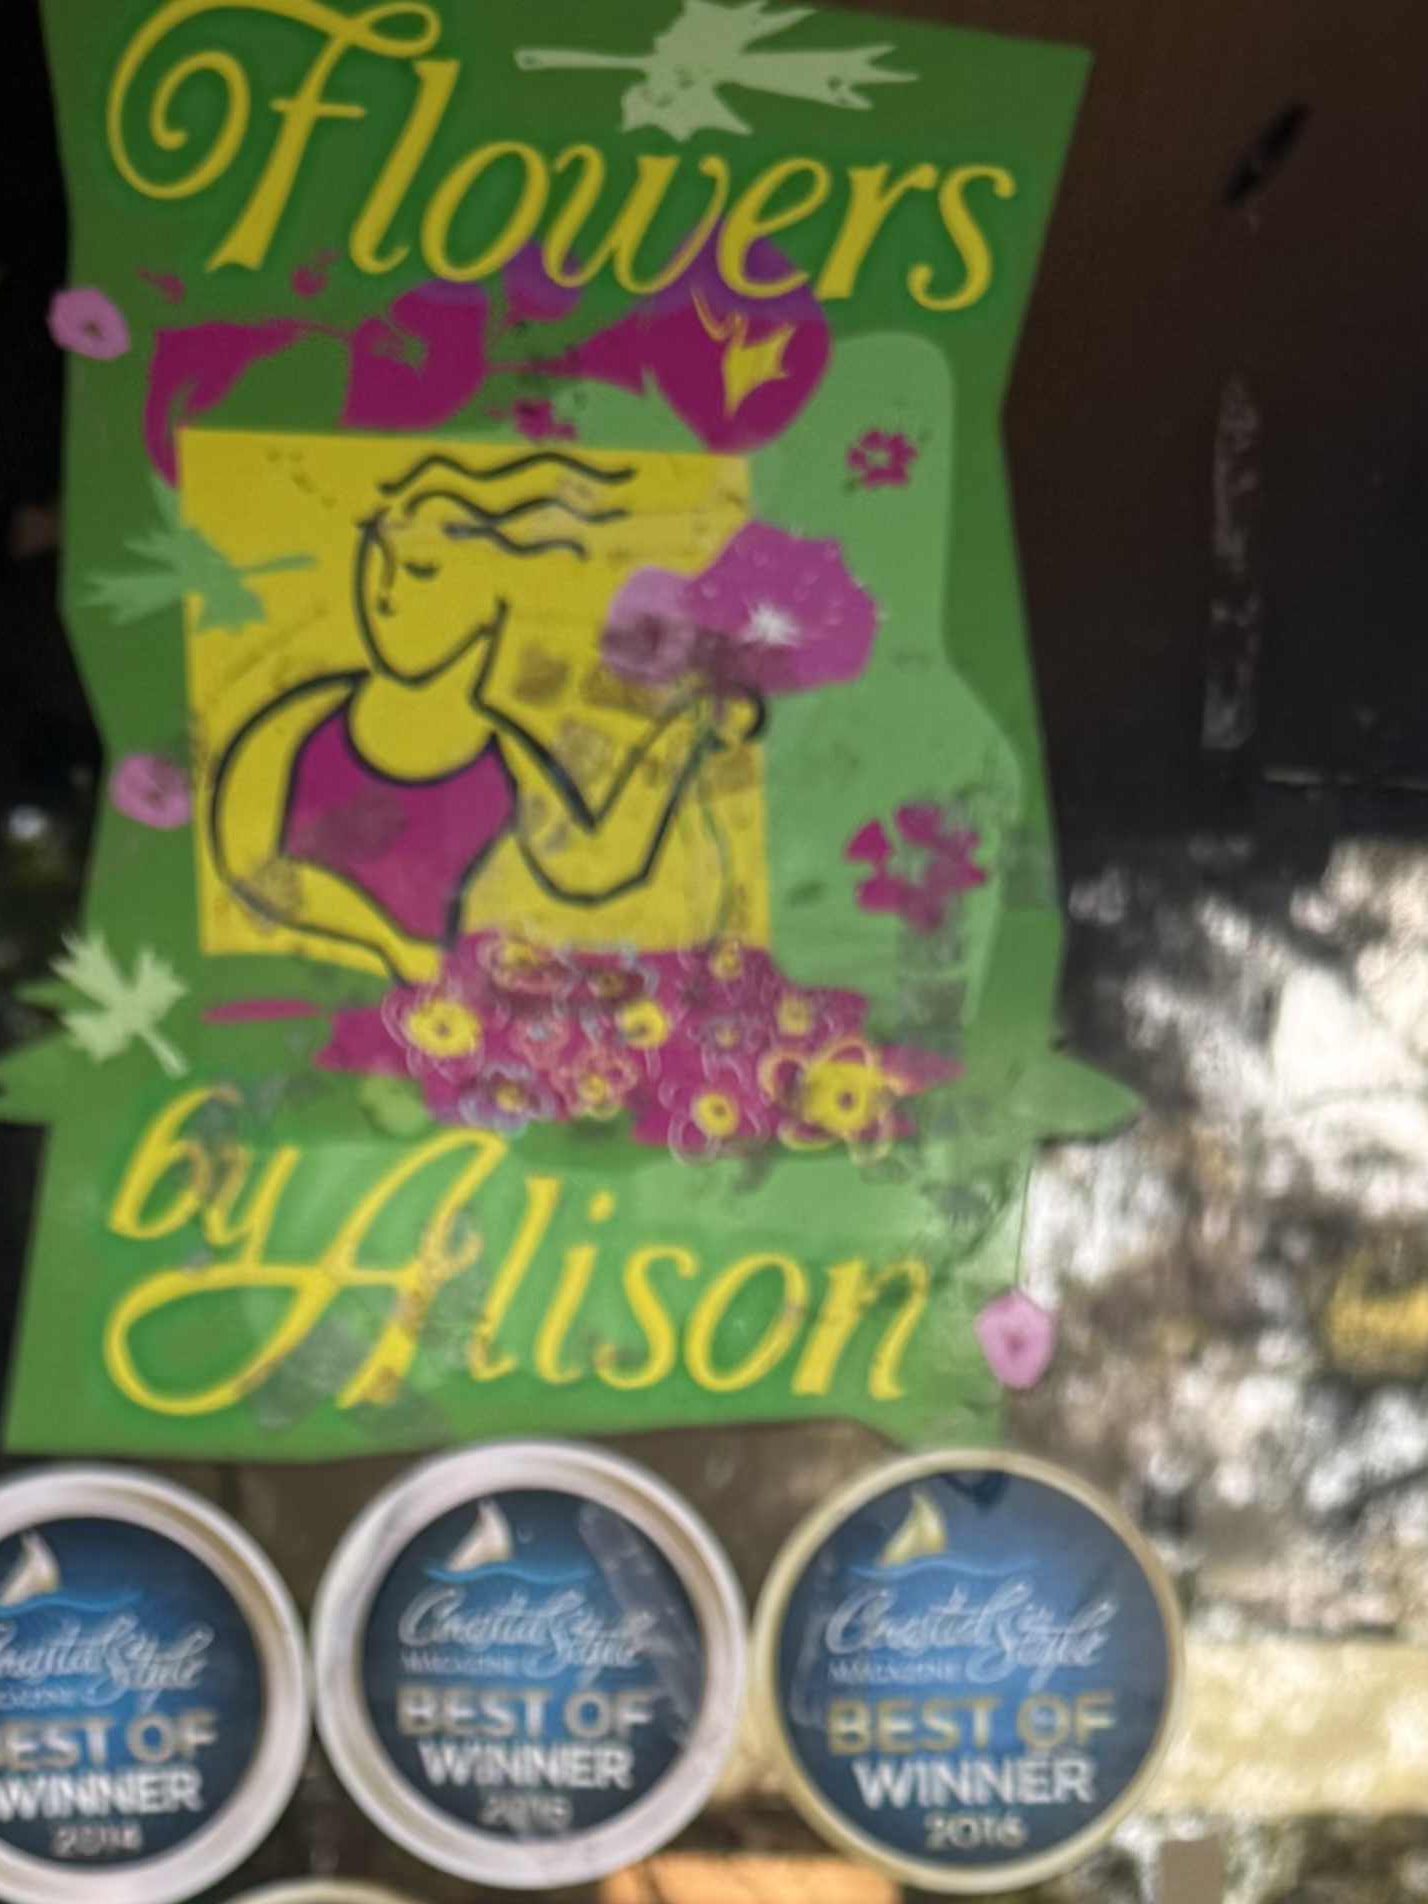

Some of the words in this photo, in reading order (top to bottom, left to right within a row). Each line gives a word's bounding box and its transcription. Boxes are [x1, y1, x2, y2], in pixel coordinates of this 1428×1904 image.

[107, 0, 1015, 311] Flowers
[108, 1083, 302, 1266] by
[103, 1127, 930, 1416] Alison
[127, 1708, 217, 1763] OF
[397, 1685, 548, 1737] BEST
[564, 1688, 654, 1739] OF
[827, 1695, 1003, 1757] BEST
[1017, 1690, 1116, 1751] OF
[417, 1738, 633, 1789] WINNER
[851, 1753, 1095, 1809] WINNER
[925, 1813, 1028, 1850] 2016
